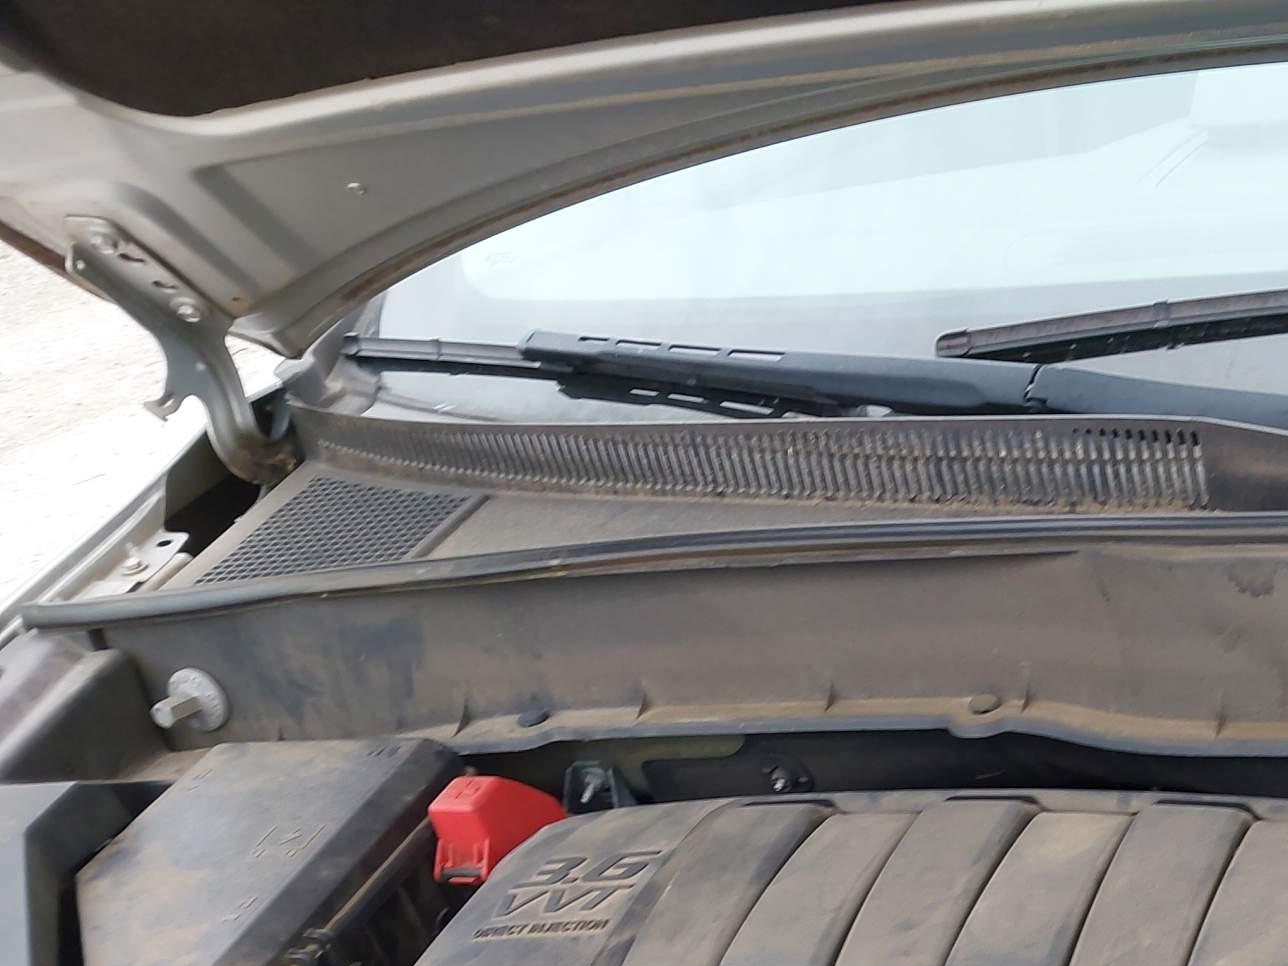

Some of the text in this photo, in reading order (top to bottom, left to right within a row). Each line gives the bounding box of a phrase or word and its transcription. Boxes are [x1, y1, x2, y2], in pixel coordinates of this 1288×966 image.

[513, 850, 662, 889] 3.6
[495, 884, 635, 917] VVT
[528, 918, 610, 935] INJECTION
